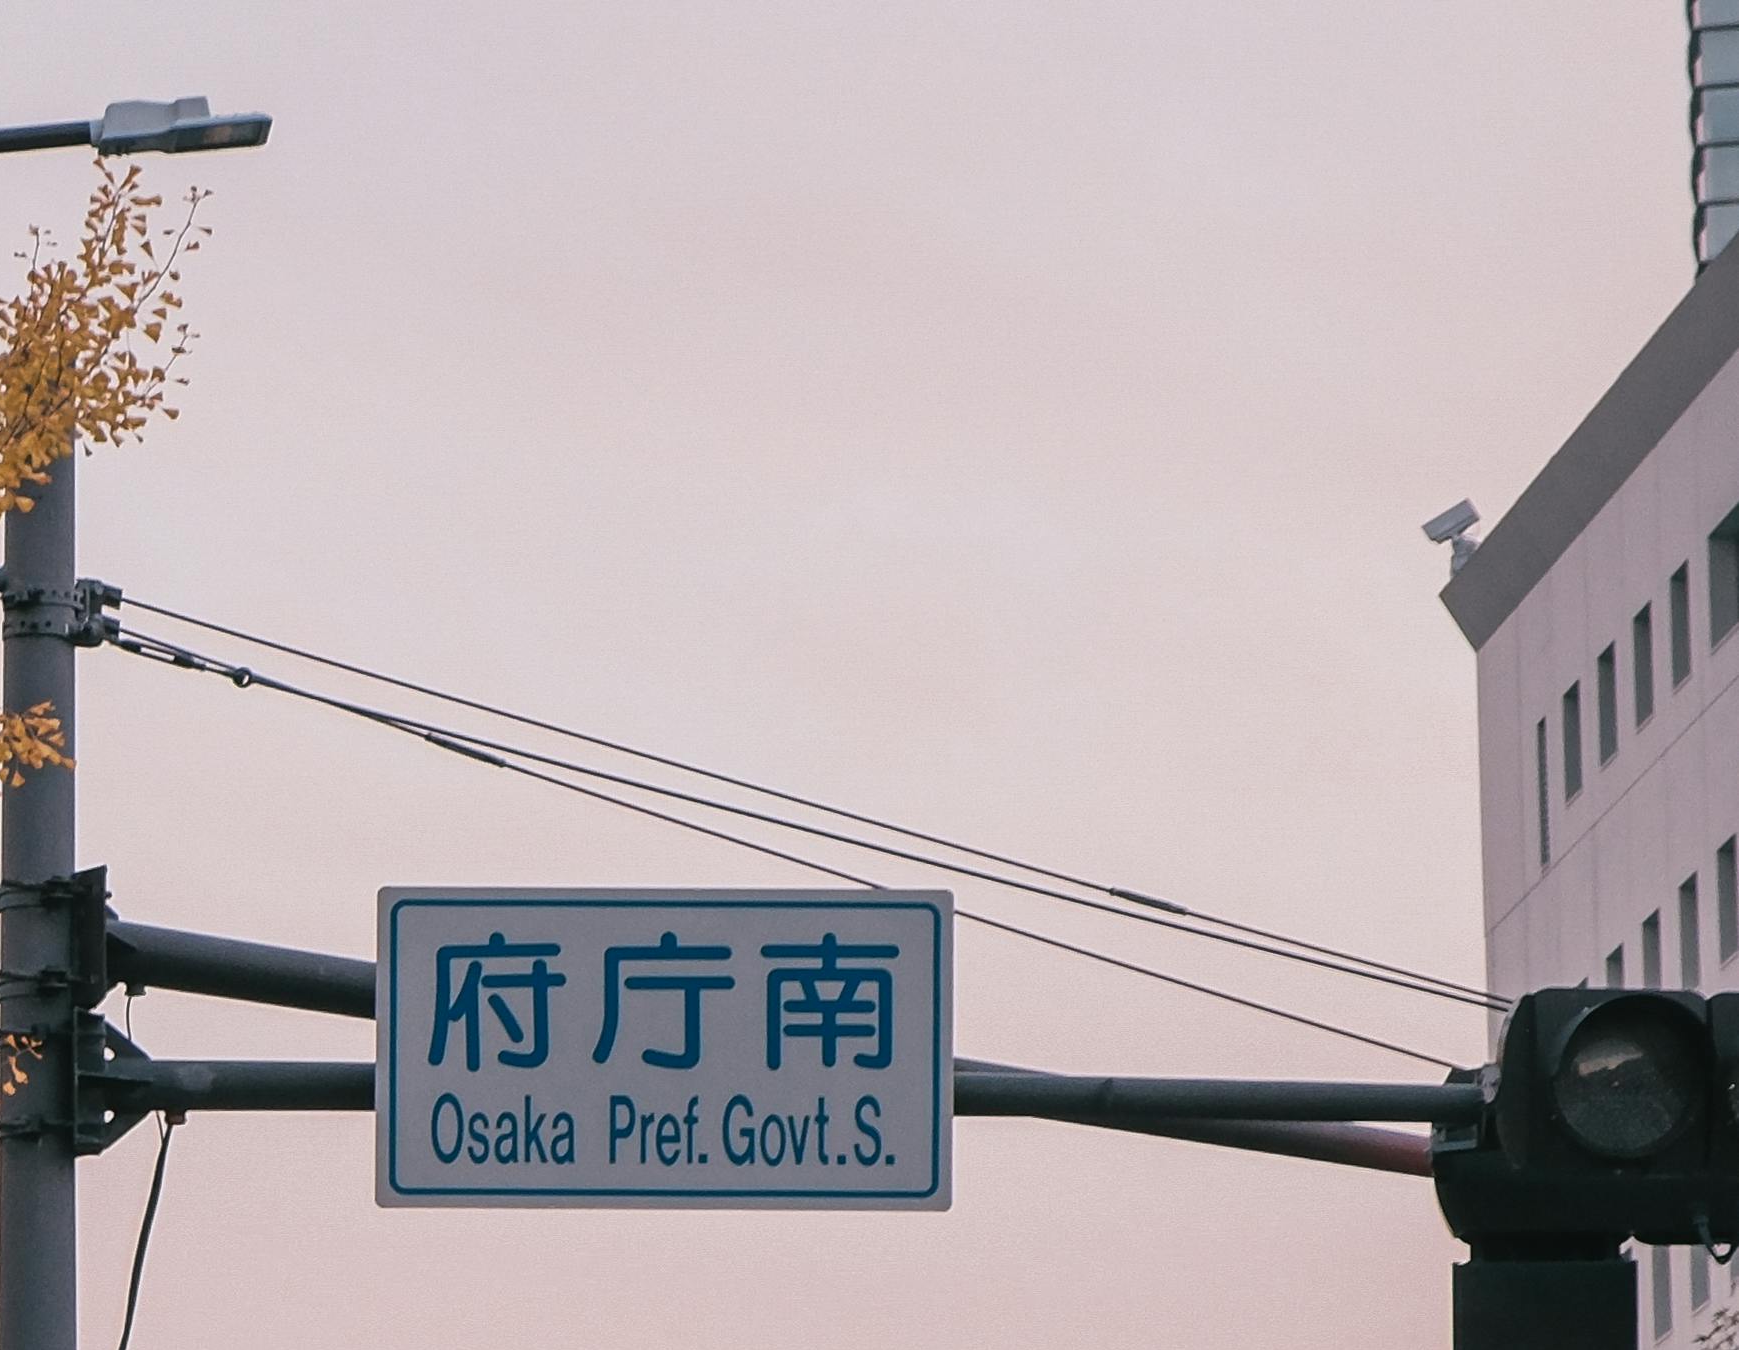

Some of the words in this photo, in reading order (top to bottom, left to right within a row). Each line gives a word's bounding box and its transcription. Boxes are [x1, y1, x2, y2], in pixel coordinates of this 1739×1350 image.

[427, 931, 900, 1072] 府庁南
[430, 1091, 576, 1165] Osaka
[608, 1093, 709, 1166] Pref.
